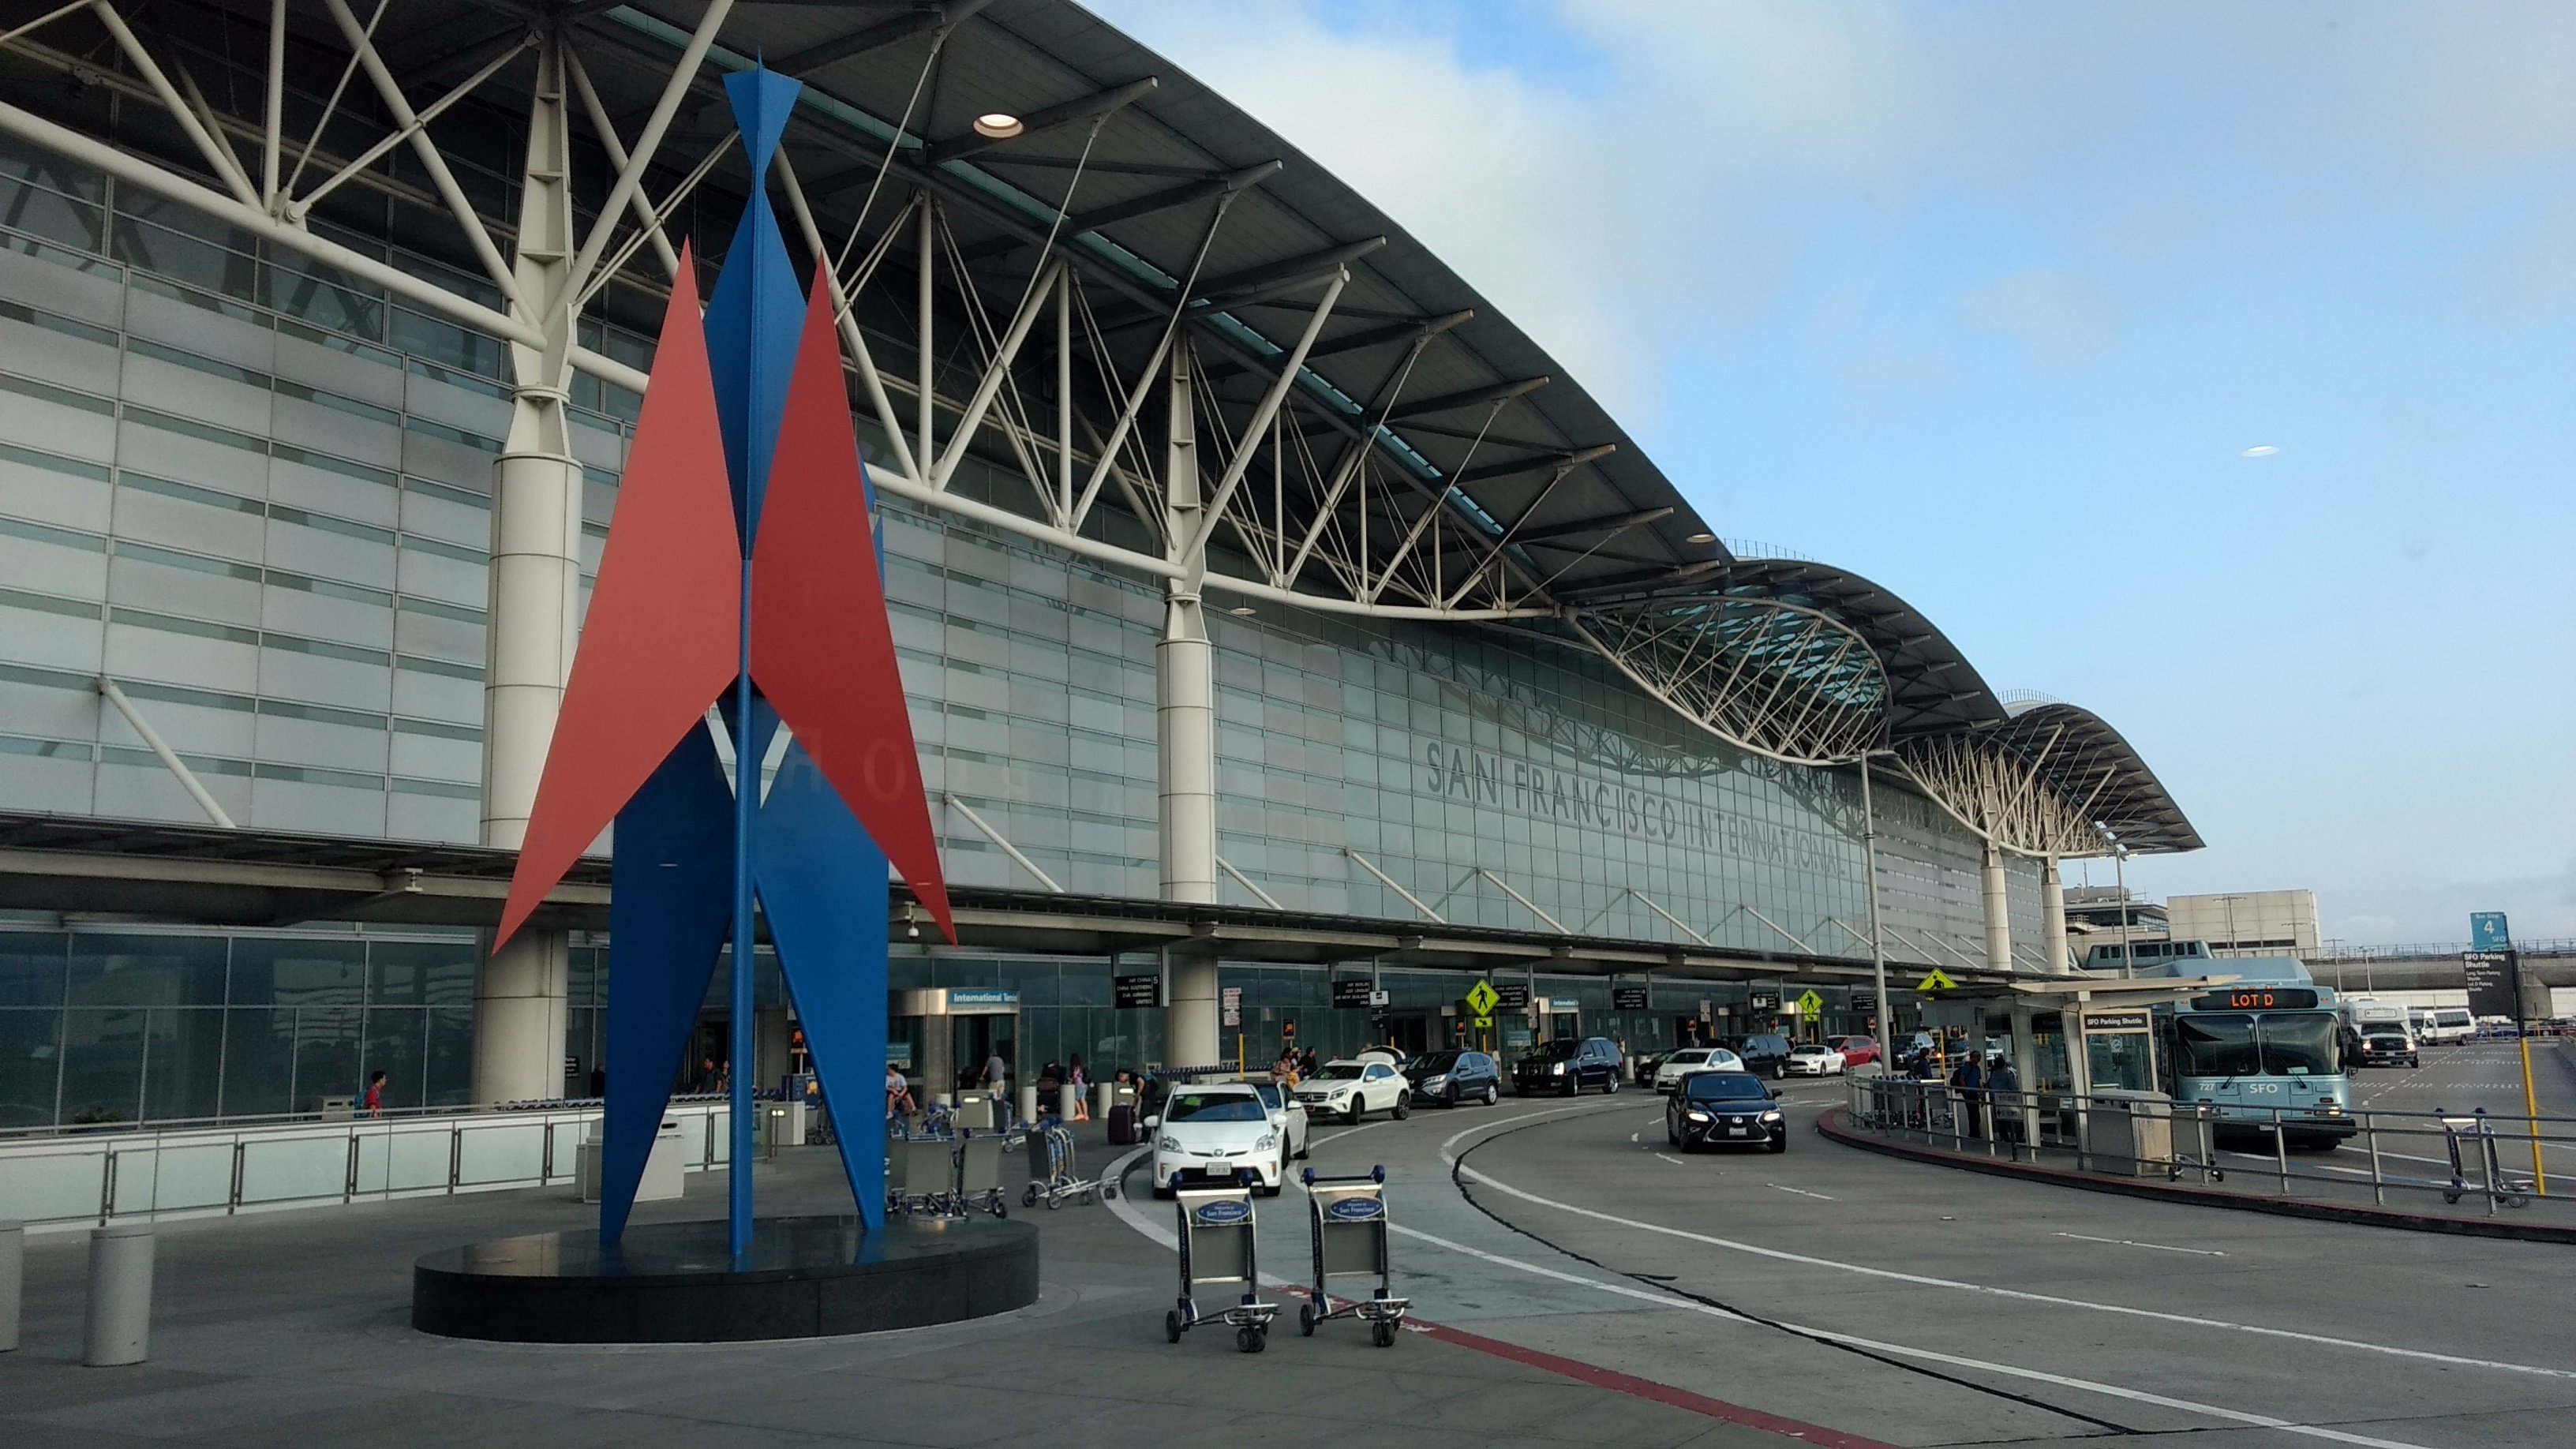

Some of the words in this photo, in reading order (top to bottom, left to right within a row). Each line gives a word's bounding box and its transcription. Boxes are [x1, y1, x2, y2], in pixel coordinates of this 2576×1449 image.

[1426, 741, 1497, 804] SAN
[1514, 762, 1676, 840] FRANCISCO
[1688, 806, 1845, 876] INTERNATIONAL
[2484, 920, 2495, 934] 4
[2480, 953, 2505, 961] Parking
[1153, 975, 1159, 984] 5
[953, 992, 1002, 1003] International
[2231, 994, 2259, 1006] LOT
[2263, 994, 2274, 1006] D
[2100, 1017, 2121, 1026] Parking
[2199, 1083, 2215, 1091] 727
[2249, 1083, 2278, 1094] SFO
